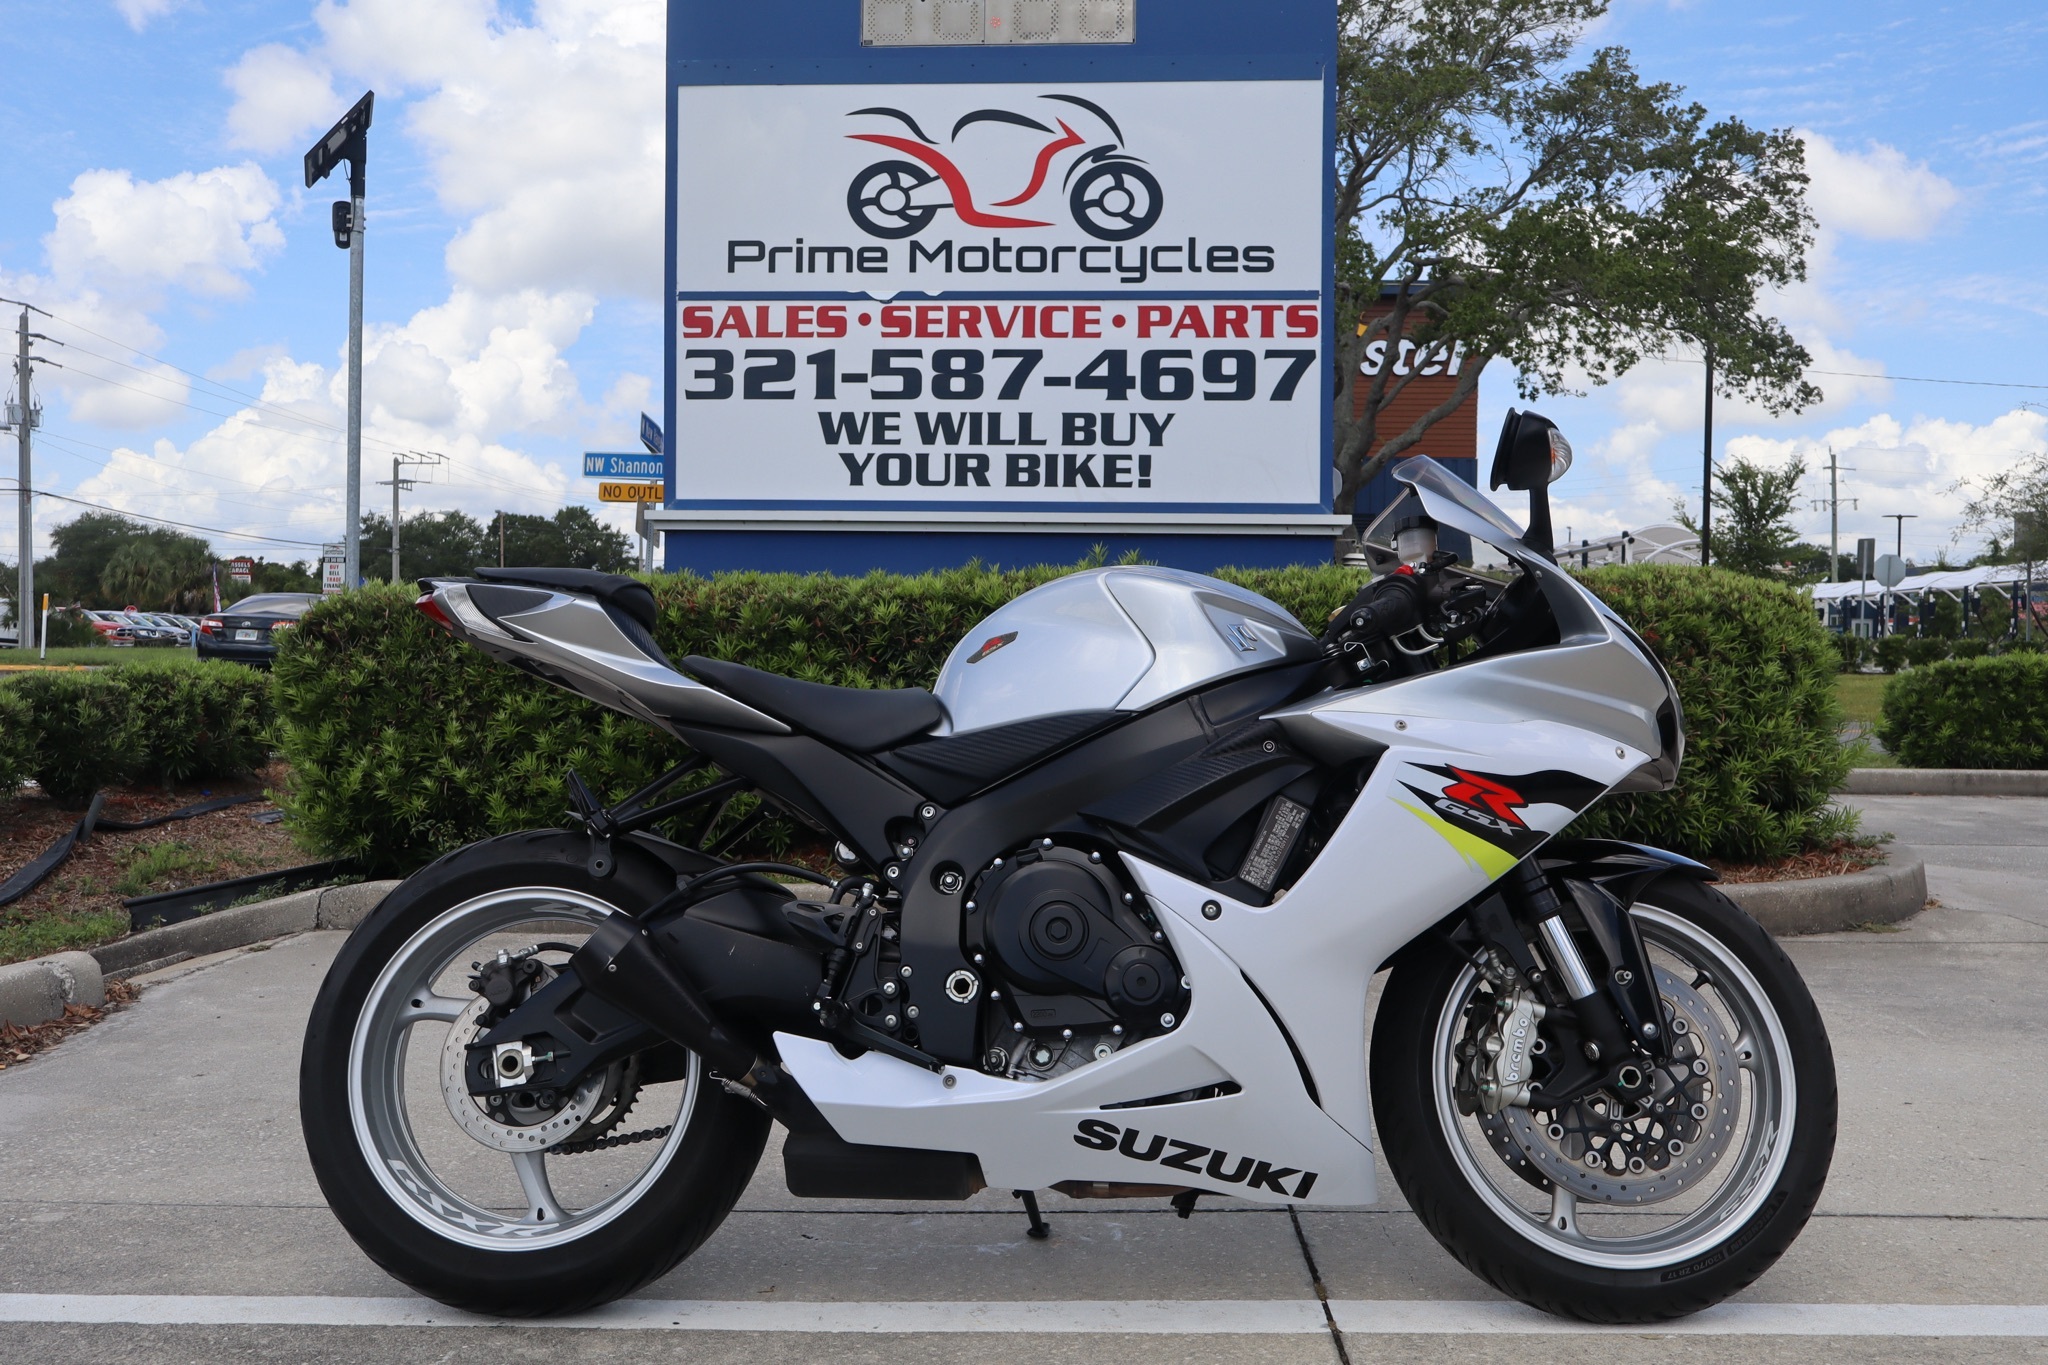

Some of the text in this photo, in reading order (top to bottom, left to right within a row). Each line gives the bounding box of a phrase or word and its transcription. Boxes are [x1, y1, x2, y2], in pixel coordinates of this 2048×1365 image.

[728, 236, 1275, 284] Prime Motorcycles
[682, 304, 1319, 339] SALES SERVICE PARTS
[684, 348, 1317, 402] 321-587-4697
[817, 411, 1176, 447] WE WILL BUY
[586, 457, 663, 475] NW Shannon
[837, 452, 1152, 489] YOUR BIKE!
[603, 485, 663, 500] NO OUTL
[1434, 798, 1524, 837] GSX
[1505, 1017, 1530, 1083] brembo
[1073, 1118, 1319, 1200] SUZUKI
